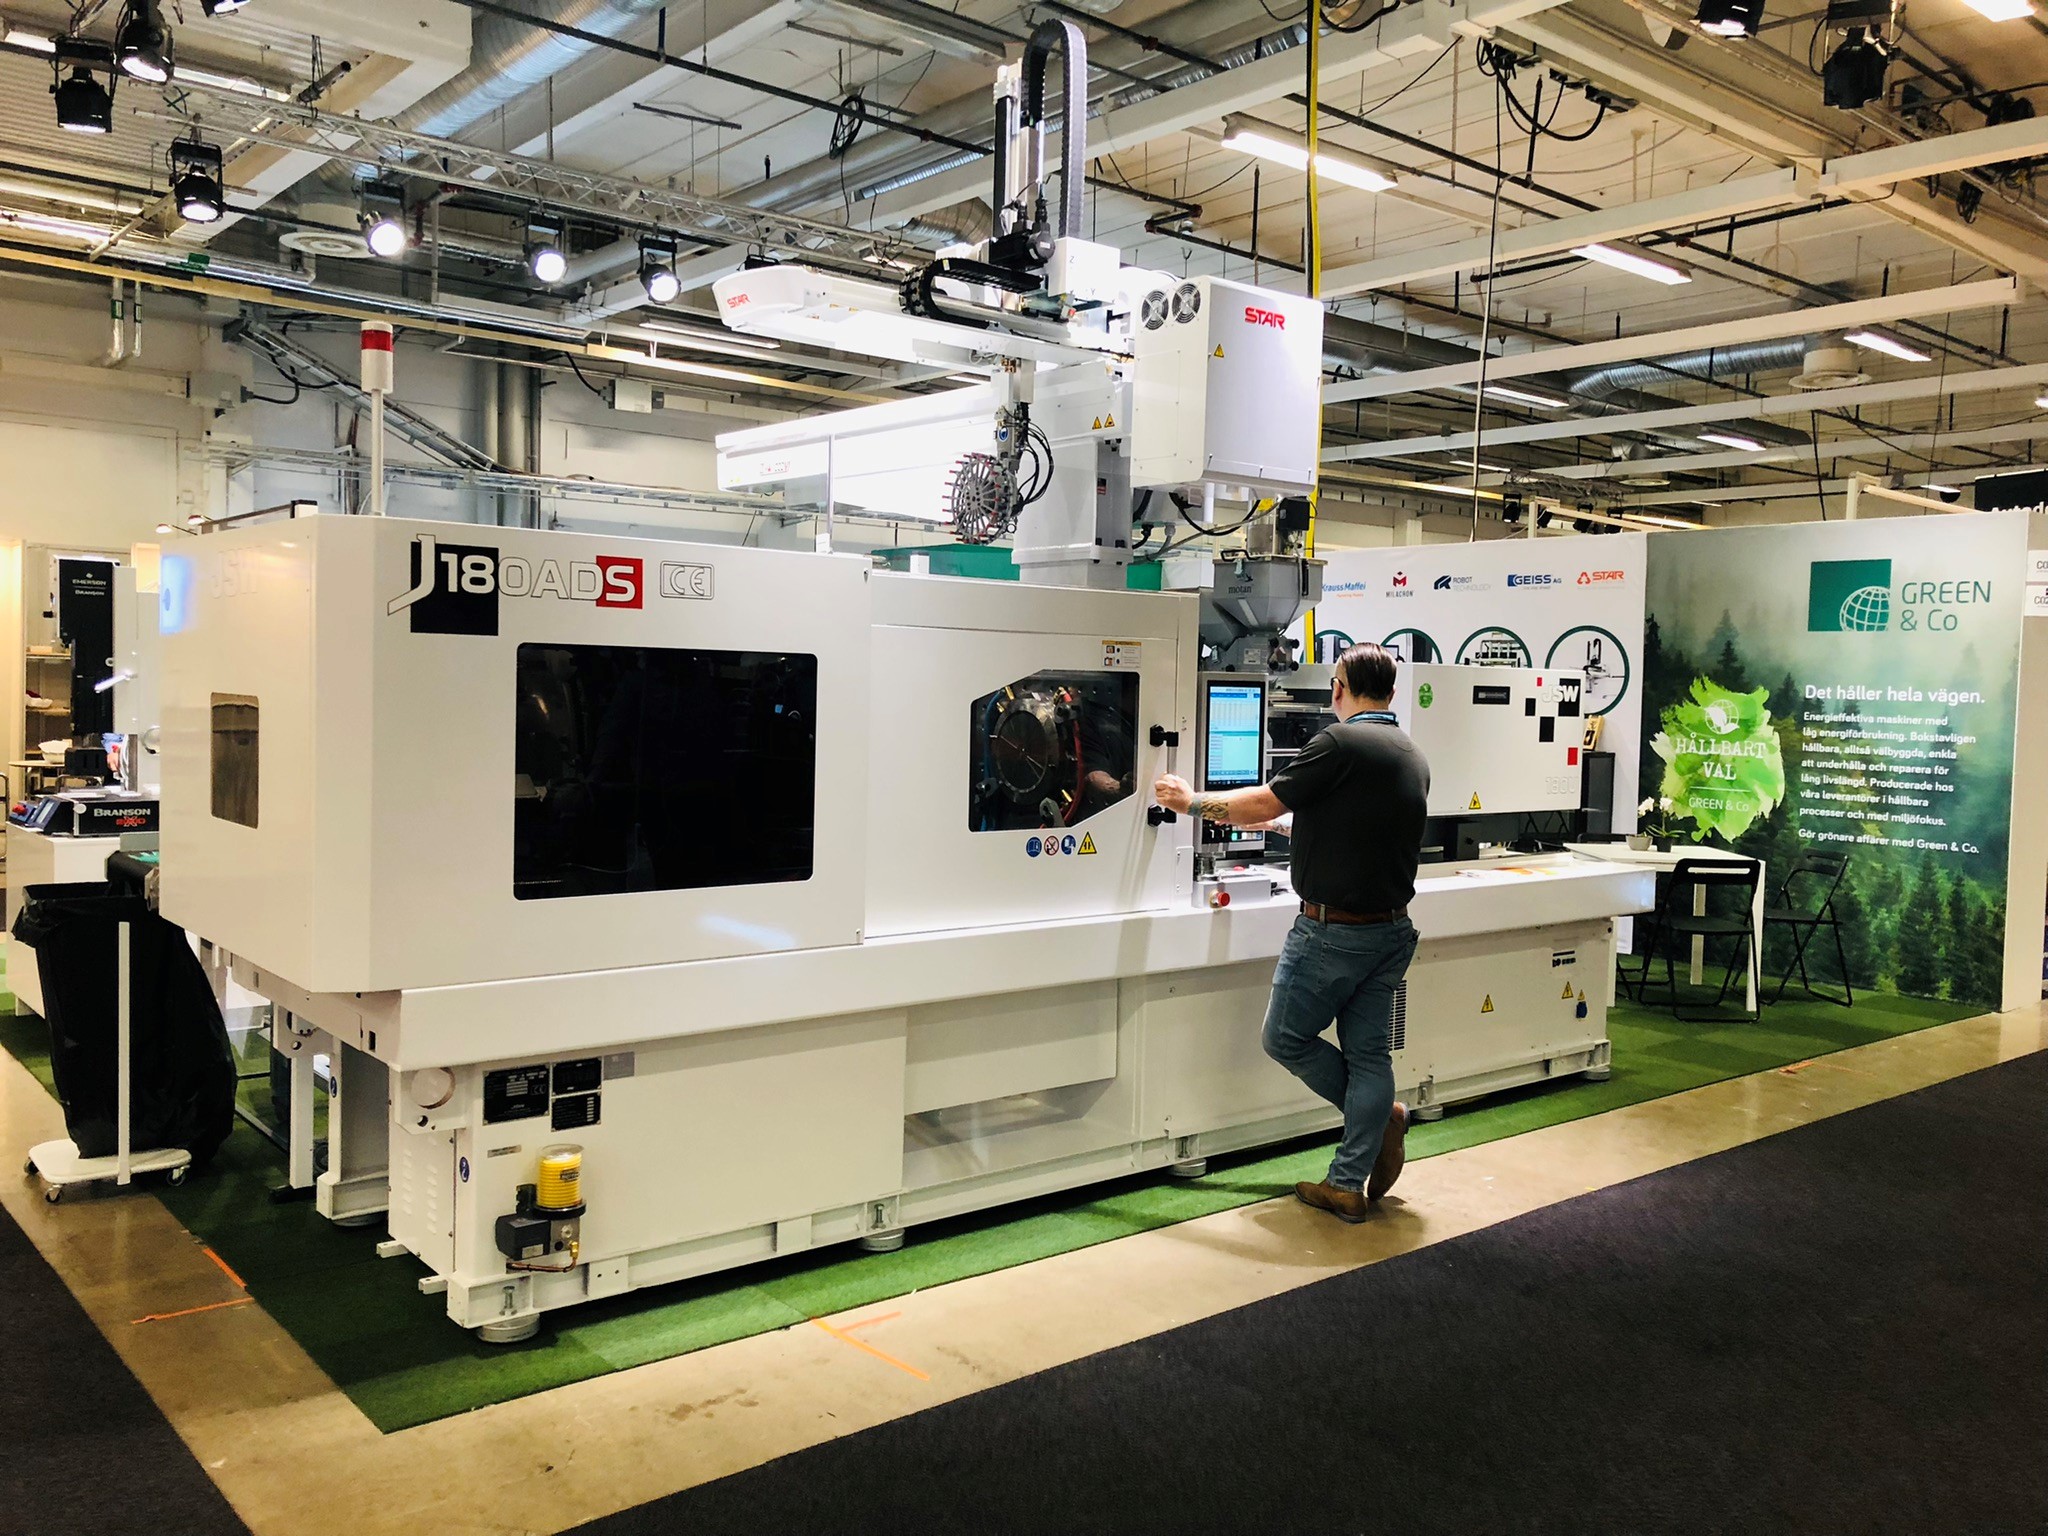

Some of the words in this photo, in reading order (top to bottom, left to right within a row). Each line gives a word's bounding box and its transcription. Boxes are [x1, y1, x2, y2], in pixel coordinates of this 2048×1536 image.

[727, 293, 751, 309] STAR
[1244, 306, 1286, 331] STAR
[387, 533, 637, 616] J180ADS
[1452, 576, 1473, 584] ROBOT
[1514, 574, 1552, 585] GEISS
[1592, 570, 1625, 581] STAR
[1228, 585, 1252, 594] motan
[1344, 581, 1367, 591] Maffei
[1385, 590, 1414, 598] MILACRON
[1902, 580, 1992, 605] GREEN
[1900, 608, 1918, 632] &
[1927, 608, 1958, 632] Co
[1541, 684, 1579, 703] JSW
[1805, 684, 1831, 700] Det
[1836, 684, 1882, 701] håller
[1887, 686, 1923, 702] hela
[1928, 688, 1986, 706] vägen.
[1803, 711, 1875, 724] Energieffektiva
[1876, 714, 1922, 726] maskiner
[1925, 716, 1948, 726] med
[1675, 731, 1767, 759] HÅLLBART
[1802, 727, 1817, 739] låg
[1819, 727, 1908, 742] energiförbrukning.
[1910, 731, 1977, 745] Bokstavligen
[1802, 743, 1843, 755] hållbara,
[1844, 744, 1871, 755] alltså
[1872, 745, 1927, 760] välbyggda,
[1928, 749, 1958, 760] enkla
[1703, 761, 1737, 781] VAL
[1801, 760, 1815, 769] att
[1816, 760, 1867, 771] underhålla
[1868, 762, 1887, 772] och
[1889, 765, 1932, 776] reparera
[1933, 764, 1950, 776] för
[1800, 773, 1821, 786] lång
[1822, 774, 1868, 789] livslängd.
[1869, 777, 1933, 792] Producerade
[1935, 782, 1955, 793] hos
[1688, 796, 1723, 810] GREEN
[1725, 799, 1734, 811] &
[1735, 800, 1750, 812] Co
[1799, 789, 1820, 800] våra
[1821, 790, 1881, 804] leverantörer
[1887, 795, 1930, 808] hållbara
[93, 807, 151, 817] BRANSON
[1799, 806, 1846, 819] processer
[1846, 810, 1865, 820] och
[1866, 811, 1889, 822] med
[1890, 812, 1947, 827] miljöfokus.
[1798, 828, 1816, 839] Gör
[1817, 831, 1855, 843] grönare
[1855, 833, 1890, 846] affärer
[1891, 837, 1915, 849] med
[1916, 838, 1949, 851] Green
[1950, 841, 1960, 852] &
[1961, 842, 1981, 854] Co.
